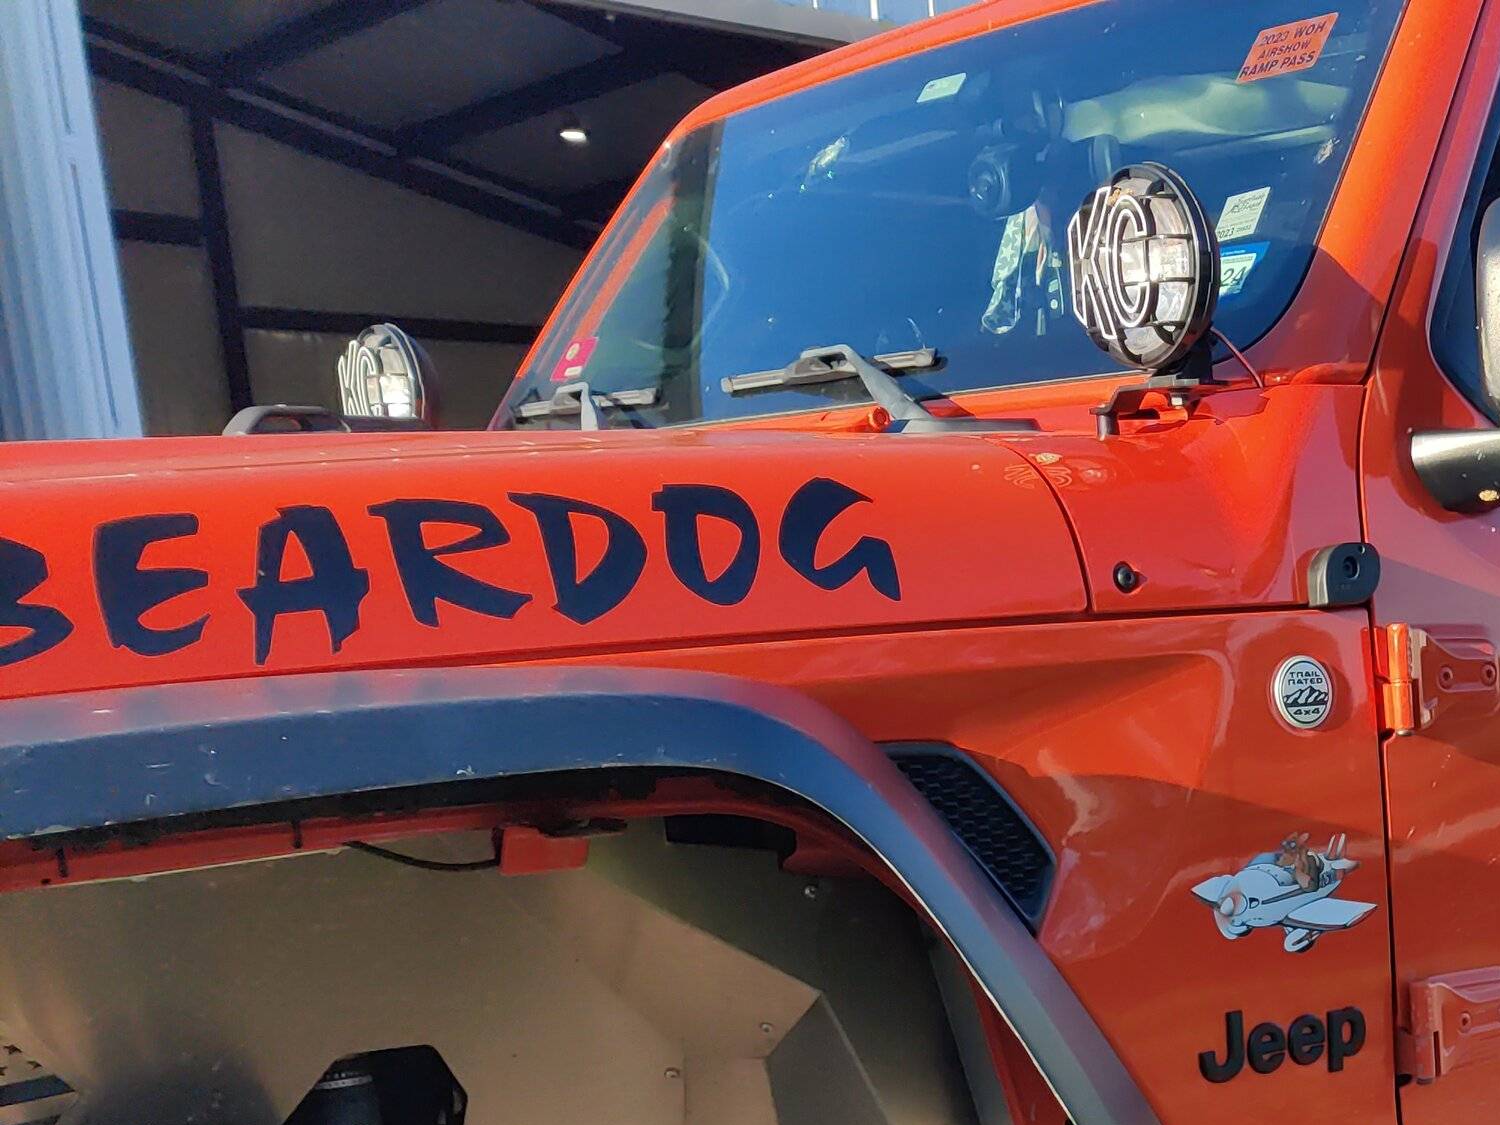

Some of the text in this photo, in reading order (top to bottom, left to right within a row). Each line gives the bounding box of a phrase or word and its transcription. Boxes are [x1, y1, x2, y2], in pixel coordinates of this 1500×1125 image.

[1258, 21, 1327, 47] 2023 WOH
[1257, 40, 1312, 60] AIRSHOW
[1239, 51, 1315, 78] RAMP PASS
[1068, 186, 1150, 339] KC
[1220, 266, 1247, 287] 24
[0, 477, 902, 668] BEARDOG
[1288, 677, 1323, 686] RATED
[1293, 707, 1320, 716] 4x4
[1198, 1006, 1367, 1083] Jeep
